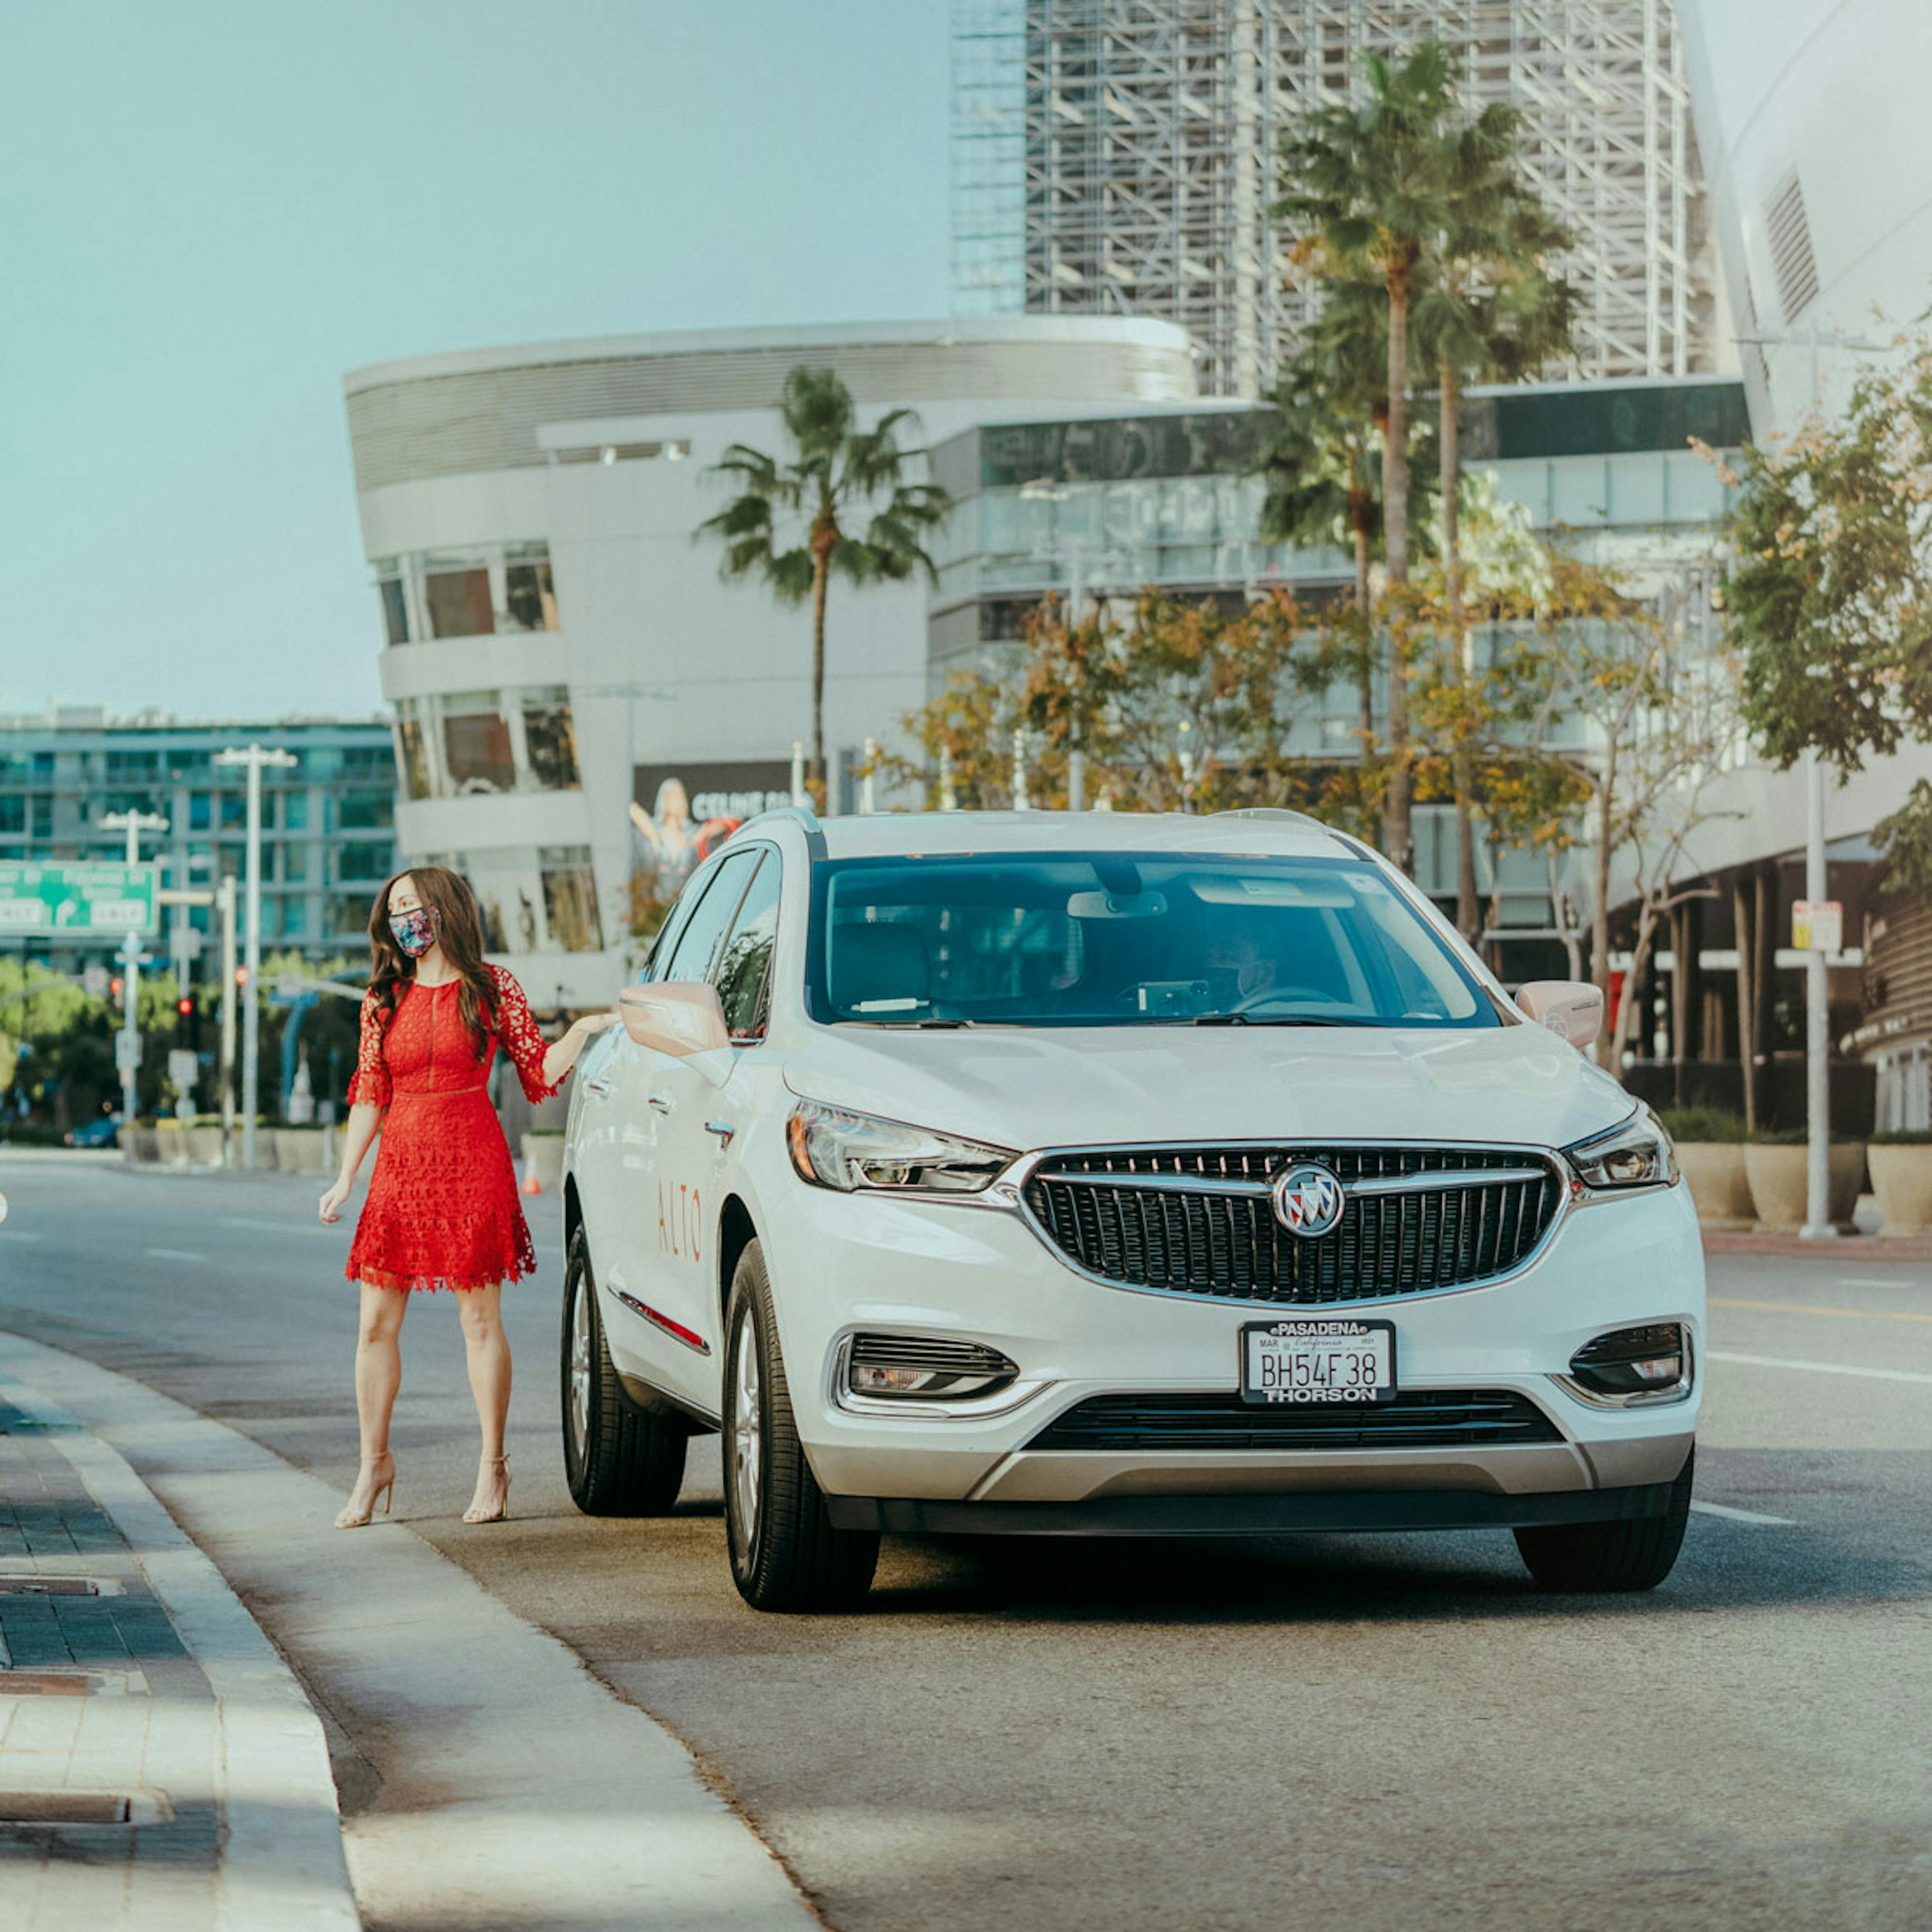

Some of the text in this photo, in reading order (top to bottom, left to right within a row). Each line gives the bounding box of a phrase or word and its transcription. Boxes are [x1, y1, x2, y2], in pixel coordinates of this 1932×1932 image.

[658, 1179, 701, 1262] ALTO
[1278, 1322, 1360, 1336] PASADENA
[1259, 1339, 1279, 1347] MAR
[1295, 1336, 1342, 1350] California
[1262, 1389, 1378, 1402] THORSON
